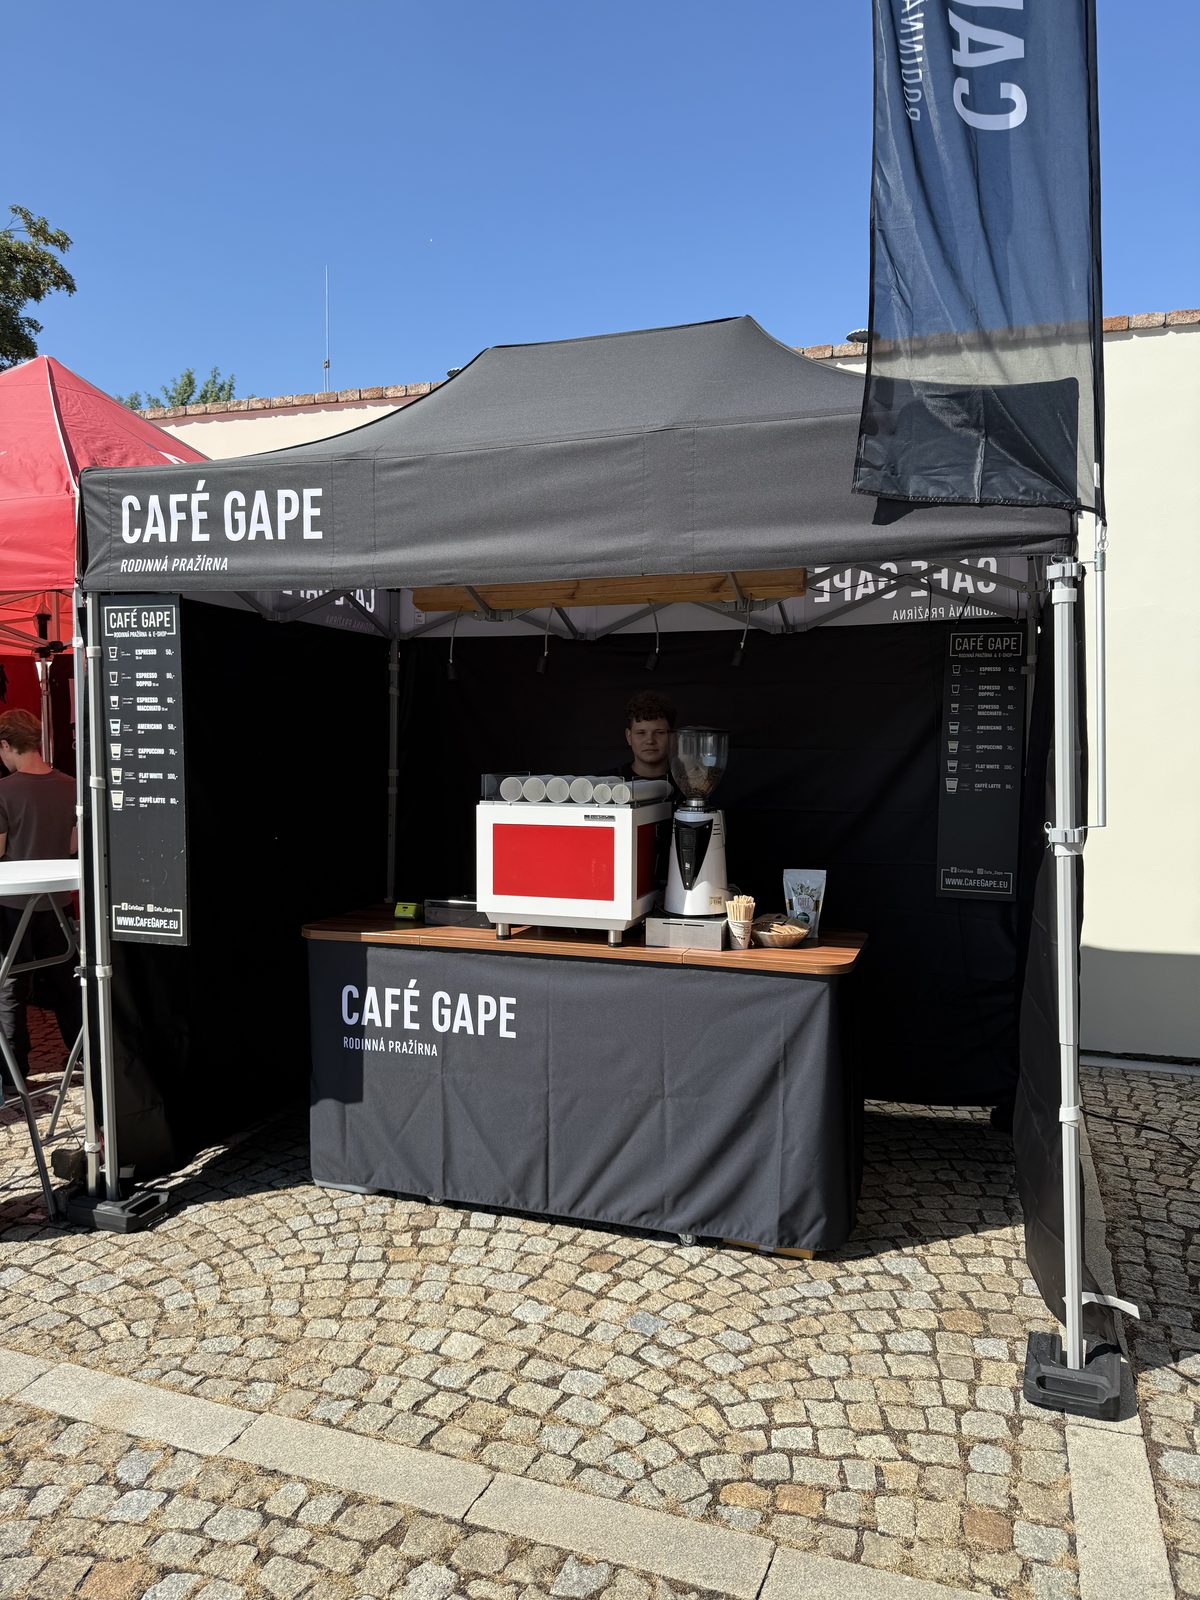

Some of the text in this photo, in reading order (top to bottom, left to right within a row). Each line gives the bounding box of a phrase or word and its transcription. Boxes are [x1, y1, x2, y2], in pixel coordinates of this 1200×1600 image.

[121, 480, 323, 544] CAFÉ GAPE
[120, 555, 228, 572] RODINNÁ PRAŽÍRNA
[110, 609, 171, 628] CAFÉ GAPE
[955, 635, 1018, 650] CAFÉ GAPE
[341, 979, 517, 1039] CAFÉ GAPE
[343, 1036, 438, 1057] RODINNÁ PRAŽÍRNA
